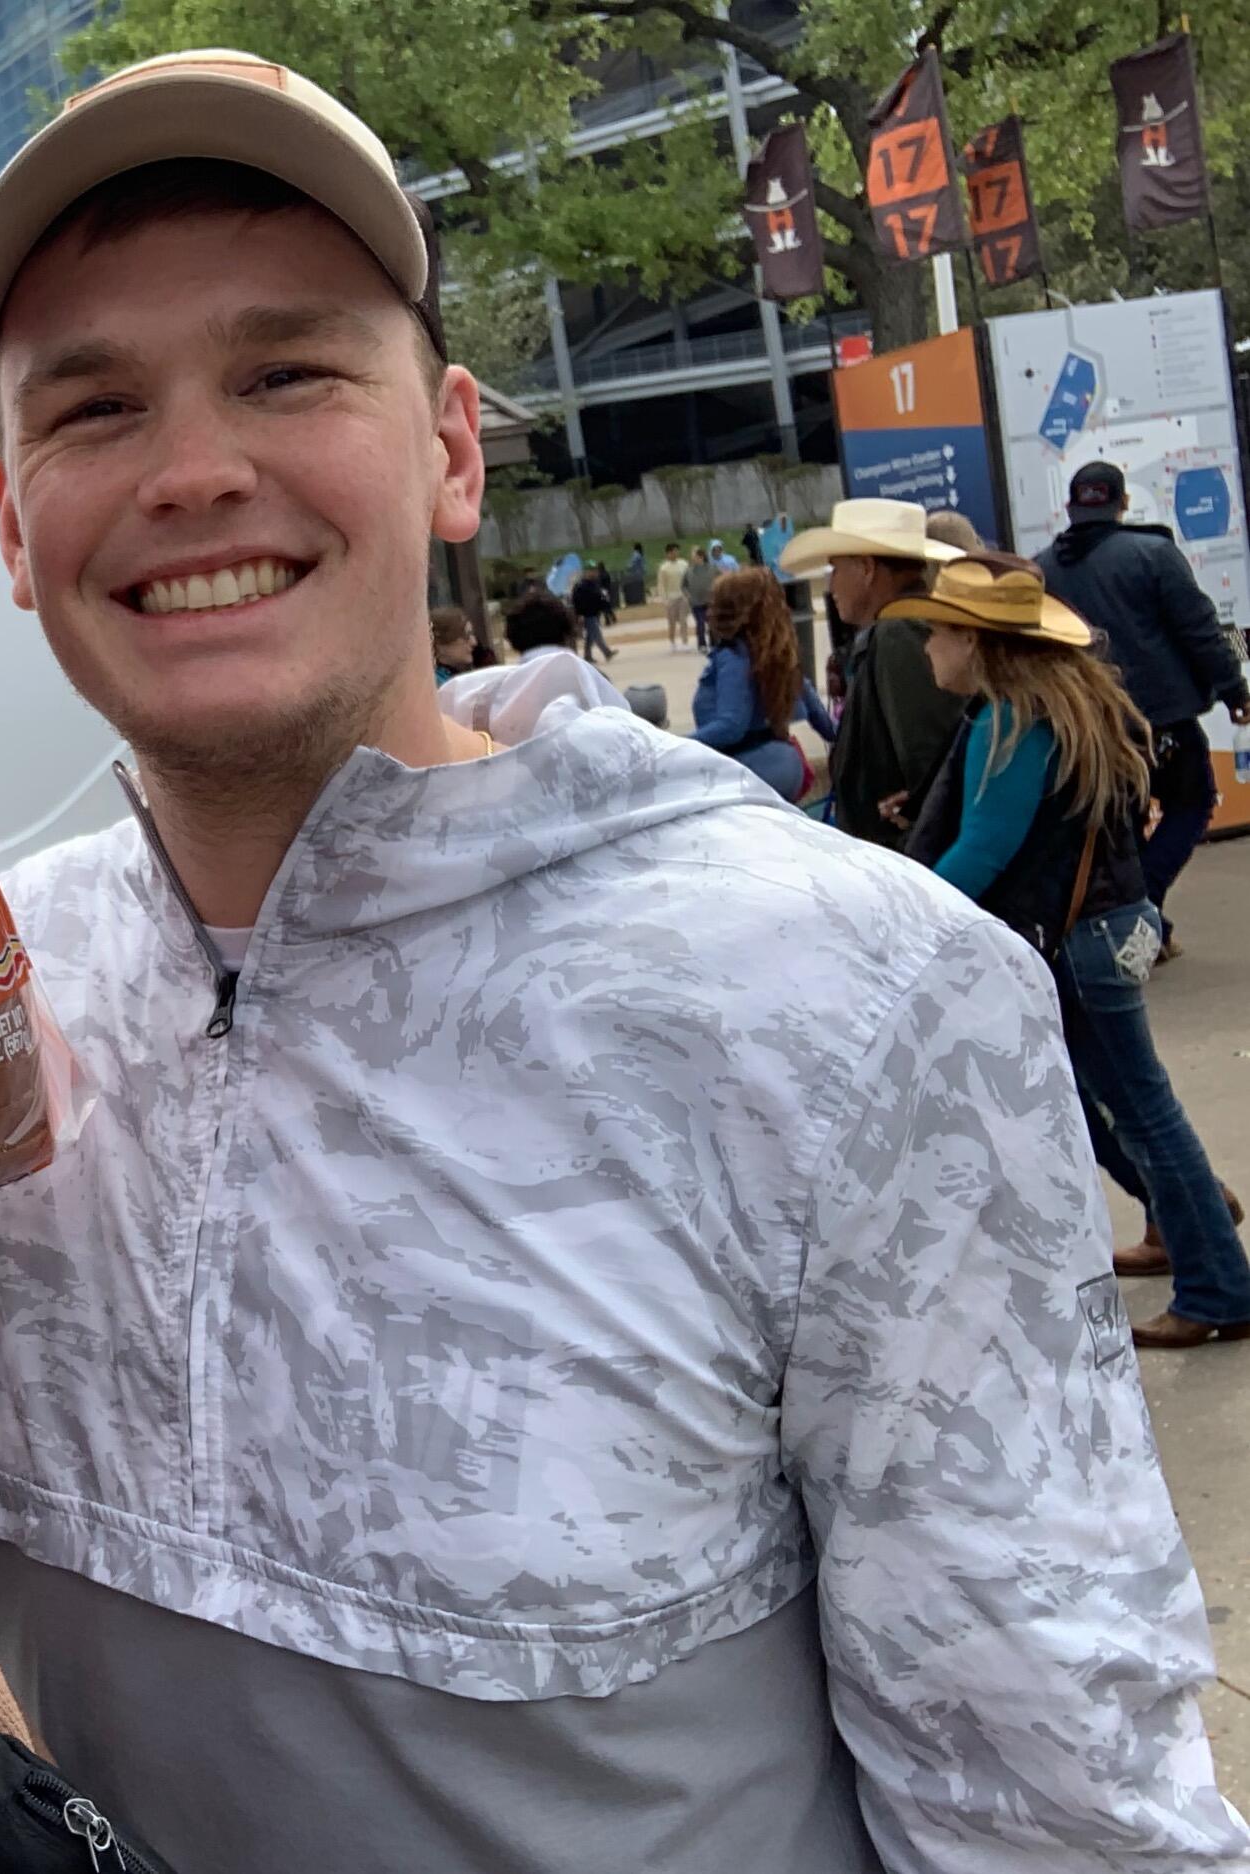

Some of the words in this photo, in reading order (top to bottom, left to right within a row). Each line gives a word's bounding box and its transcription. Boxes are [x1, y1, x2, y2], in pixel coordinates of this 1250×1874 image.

[876, 135, 928, 190] 17
[970, 175, 1011, 224] 17
[885, 203, 938, 258] 17
[981, 236, 1023, 284] 17
[889, 361, 914, 414] 17
